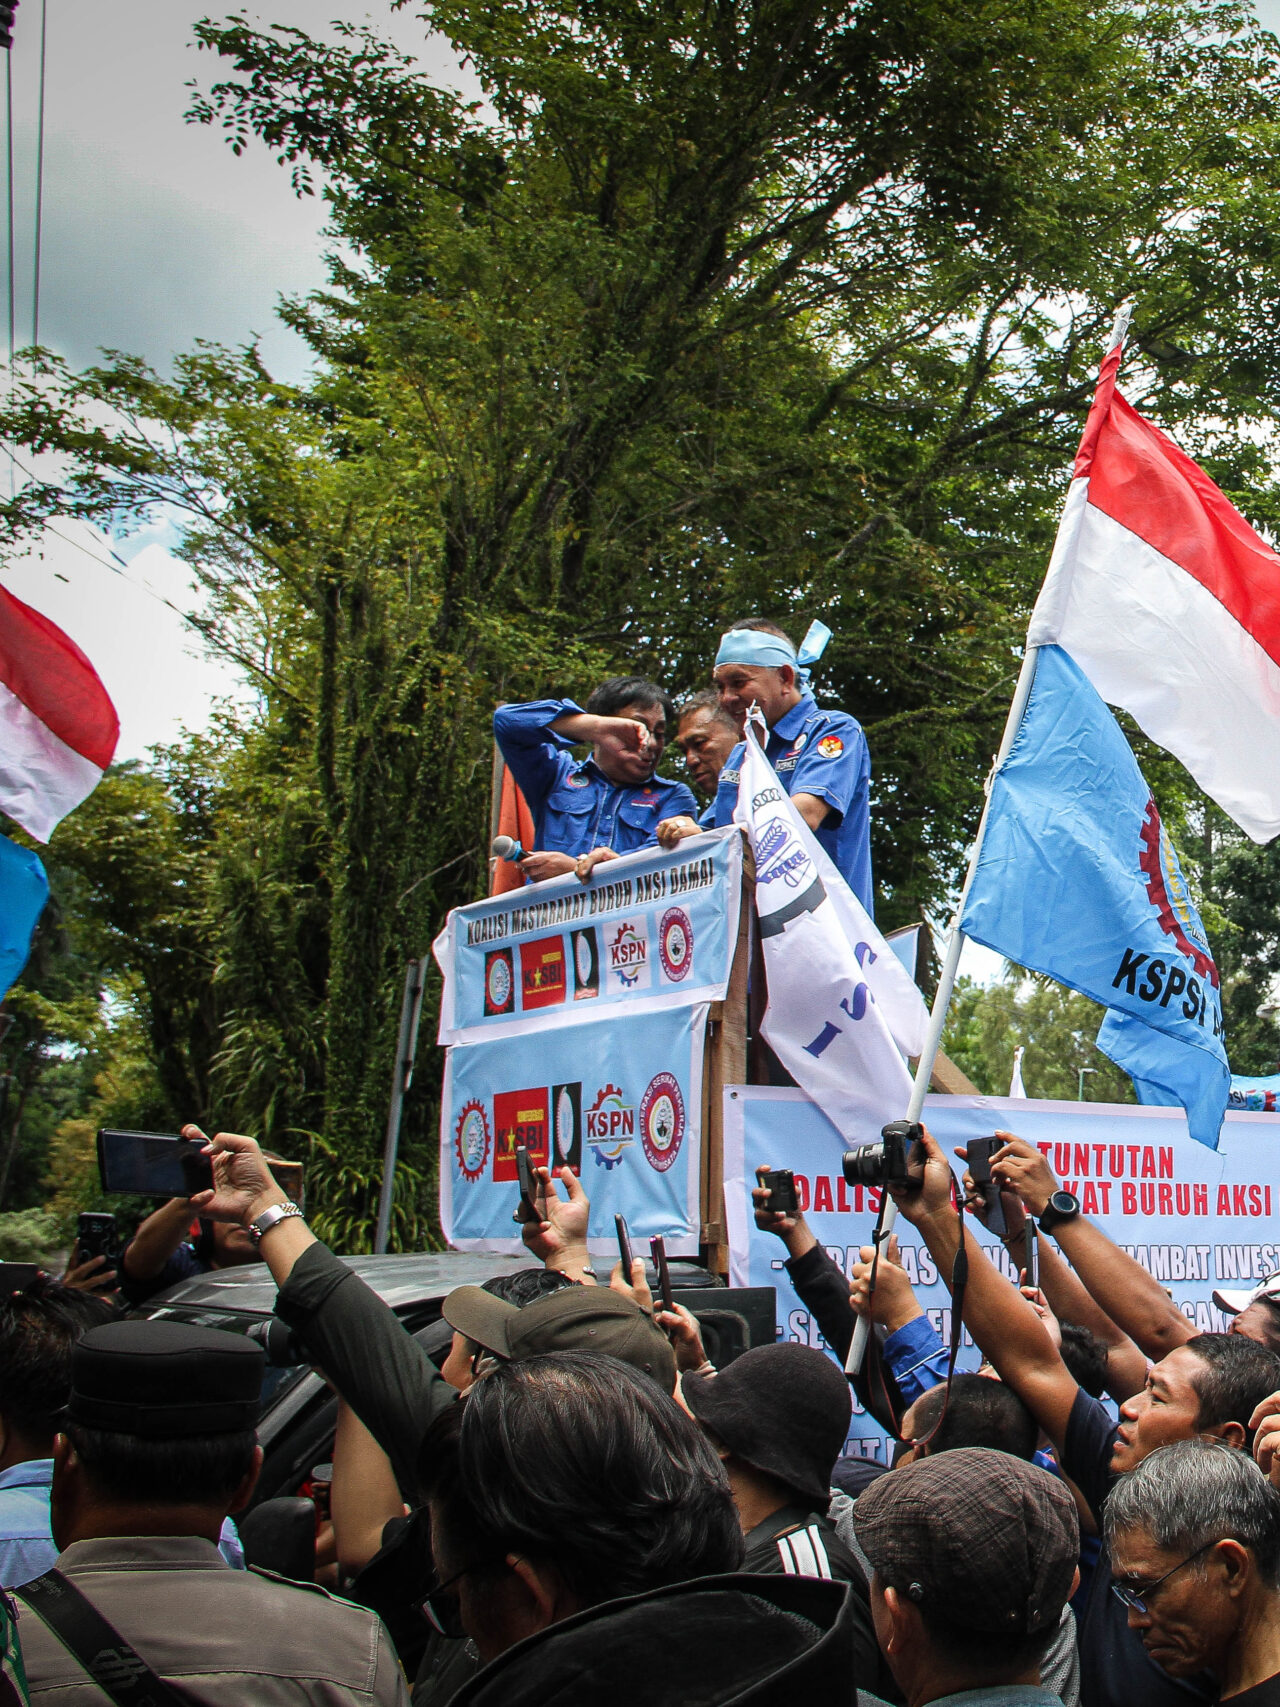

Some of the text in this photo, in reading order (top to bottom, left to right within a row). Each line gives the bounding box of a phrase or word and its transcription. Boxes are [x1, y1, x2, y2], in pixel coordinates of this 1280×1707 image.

[467, 856, 715, 947] KOALISI MASYARAKAT BURUH AKSI DAMAI
[611, 940, 647, 967] KSPN
[1111, 947, 1207, 1027] KSPSI
[587, 1109, 634, 1138] KSPN
[1036, 1141, 1174, 1179] TUNTUTAN
[794, 1176, 883, 1214] OALIS
[1121, 1182, 1209, 1216] BURUH
[1216, 1184, 1272, 1217] AKSI
